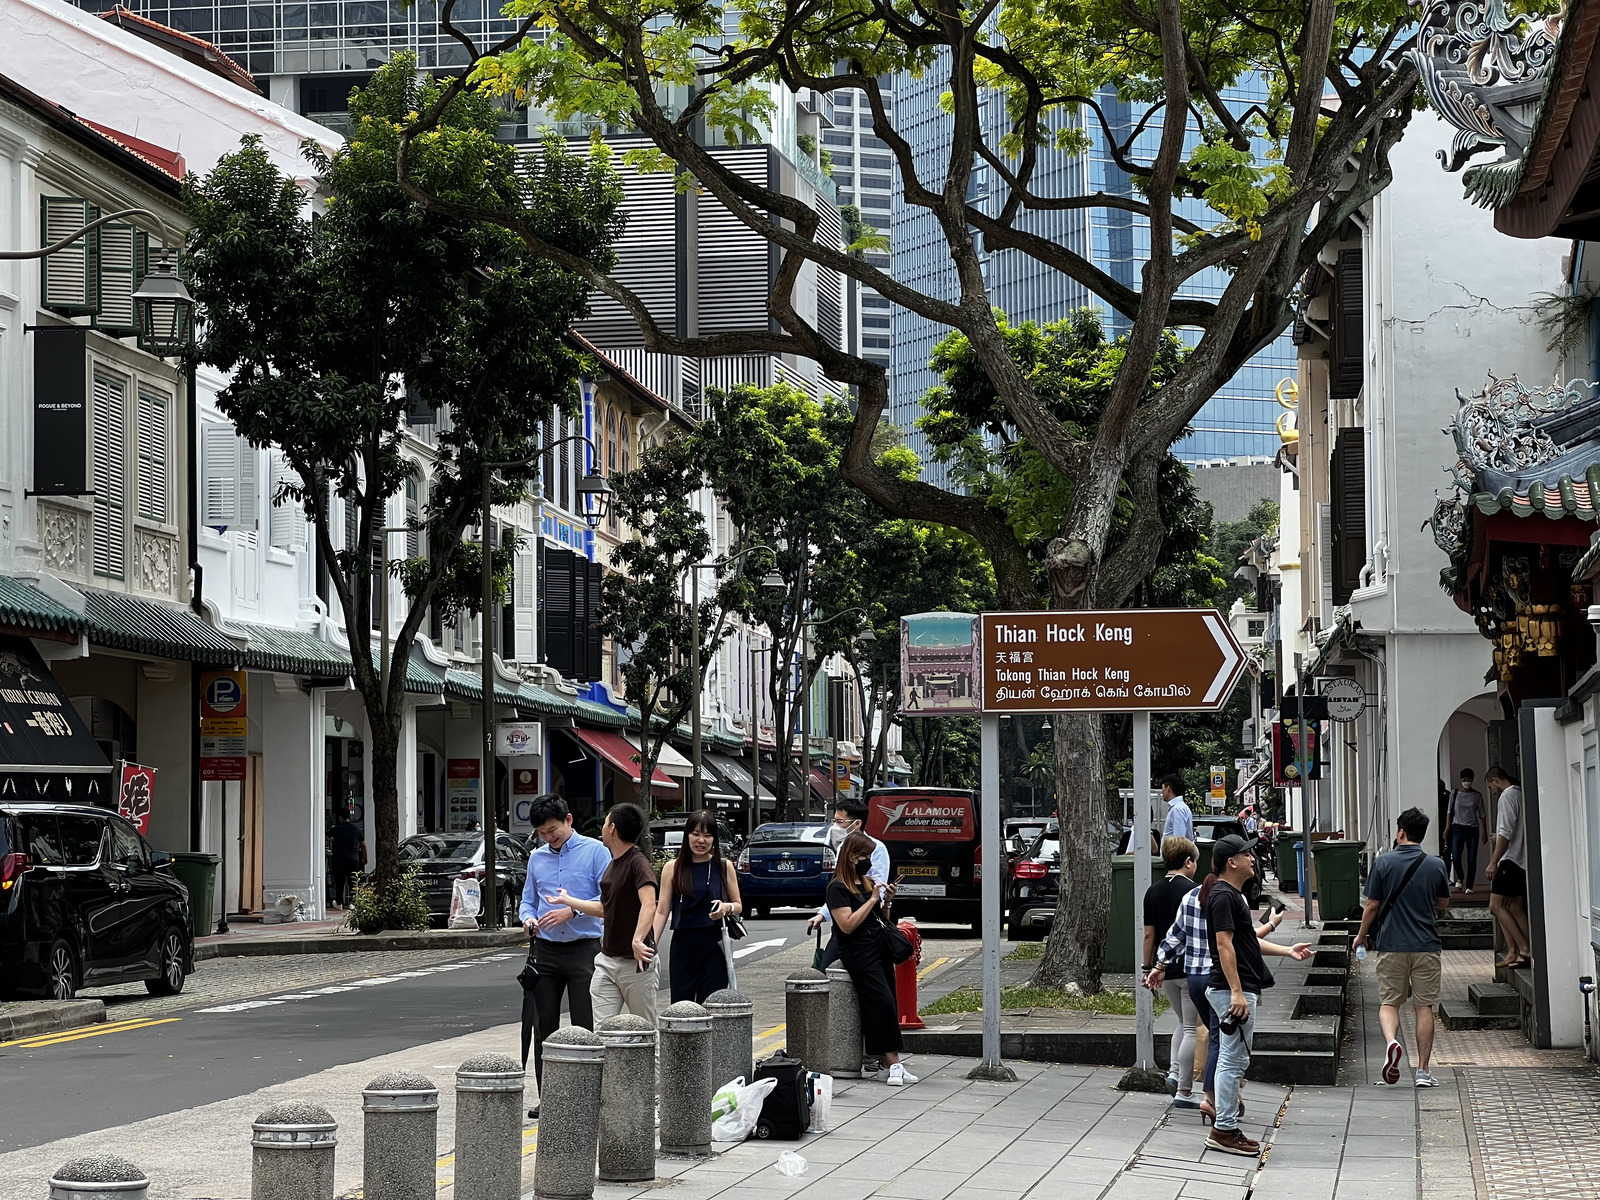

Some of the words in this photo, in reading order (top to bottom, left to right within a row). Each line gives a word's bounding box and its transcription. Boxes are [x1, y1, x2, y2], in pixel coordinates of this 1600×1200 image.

[995, 624, 1038, 643] Thian
[1046, 624, 1086, 642] Hock
[1095, 622, 1132, 646] Keng
[996, 668, 1032, 684] Tokong
[1038, 668, 1066, 680] Thian
[1072, 668, 1098, 680] Hock
[1104, 667, 1130, 682] Keng
[0, 688, 28, 704] KIRIN
[24, 690, 62, 706] ICHIBAN
[996, 686, 1036, 702] தியன்
[1040, 686, 1091, 702] ஹோக்
[1095, 684, 1129, 698] கெங்
[1133, 684, 1192, 698] கோயில்
[26, 711, 72, 736] 一番搾り
[904, 808, 965, 816] LALAMOVE
[904, 818, 930, 826] deliver
[931, 818, 952, 826] faster
